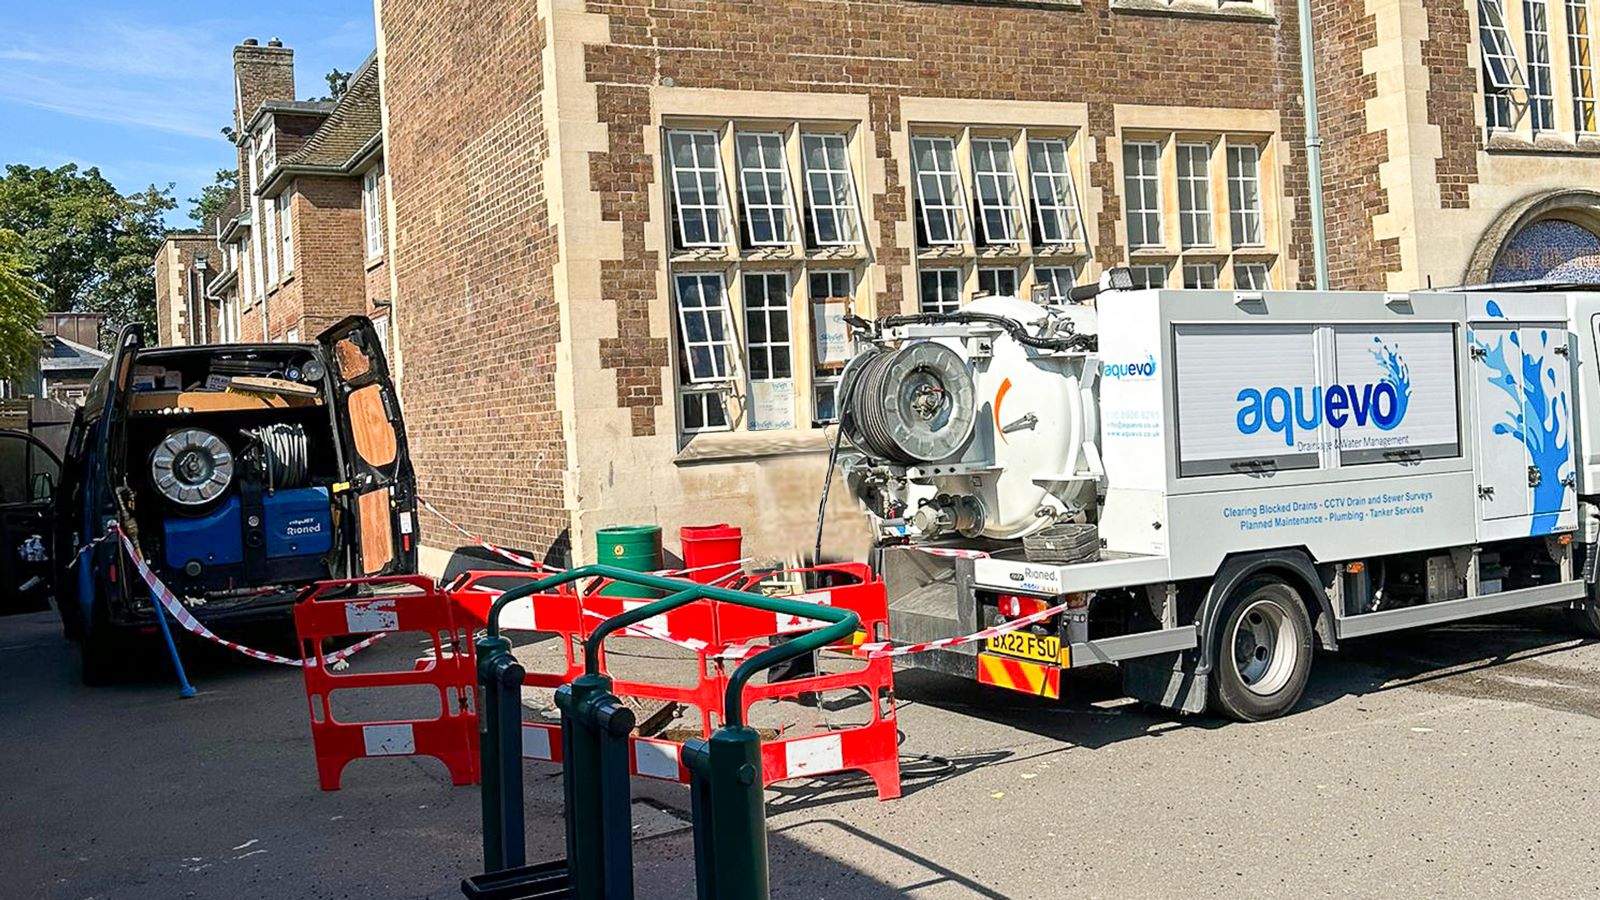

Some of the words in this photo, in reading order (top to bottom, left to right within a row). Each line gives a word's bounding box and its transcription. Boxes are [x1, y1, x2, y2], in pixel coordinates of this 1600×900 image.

[1104, 362, 1154, 380] aquevo
[1236, 383, 1402, 447] aquevo
[1363, 435, 1409, 448] Management
[1223, 507, 1258, 518] Clearing
[1259, 503, 1292, 515] Blocked
[1292, 501, 1319, 512] Drains
[1324, 498, 1346, 509] CCTV
[1346, 497, 1367, 507] Drain
[1367, 496, 1382, 505] and
[1382, 493, 1405, 504] Sewer
[1405, 492, 1433, 502] Surveys
[1240, 520, 1273, 530] Planned
[1274, 515, 1323, 527] Maintenance
[1329, 511, 1364, 522] Plumbing
[1369, 508, 1393, 518] Tanker
[1394, 505, 1424, 516] Services
[287, 522, 321, 536] Rioned
[993, 633, 1024, 654] BX22
[1027, 637, 1056, 659] FSU
